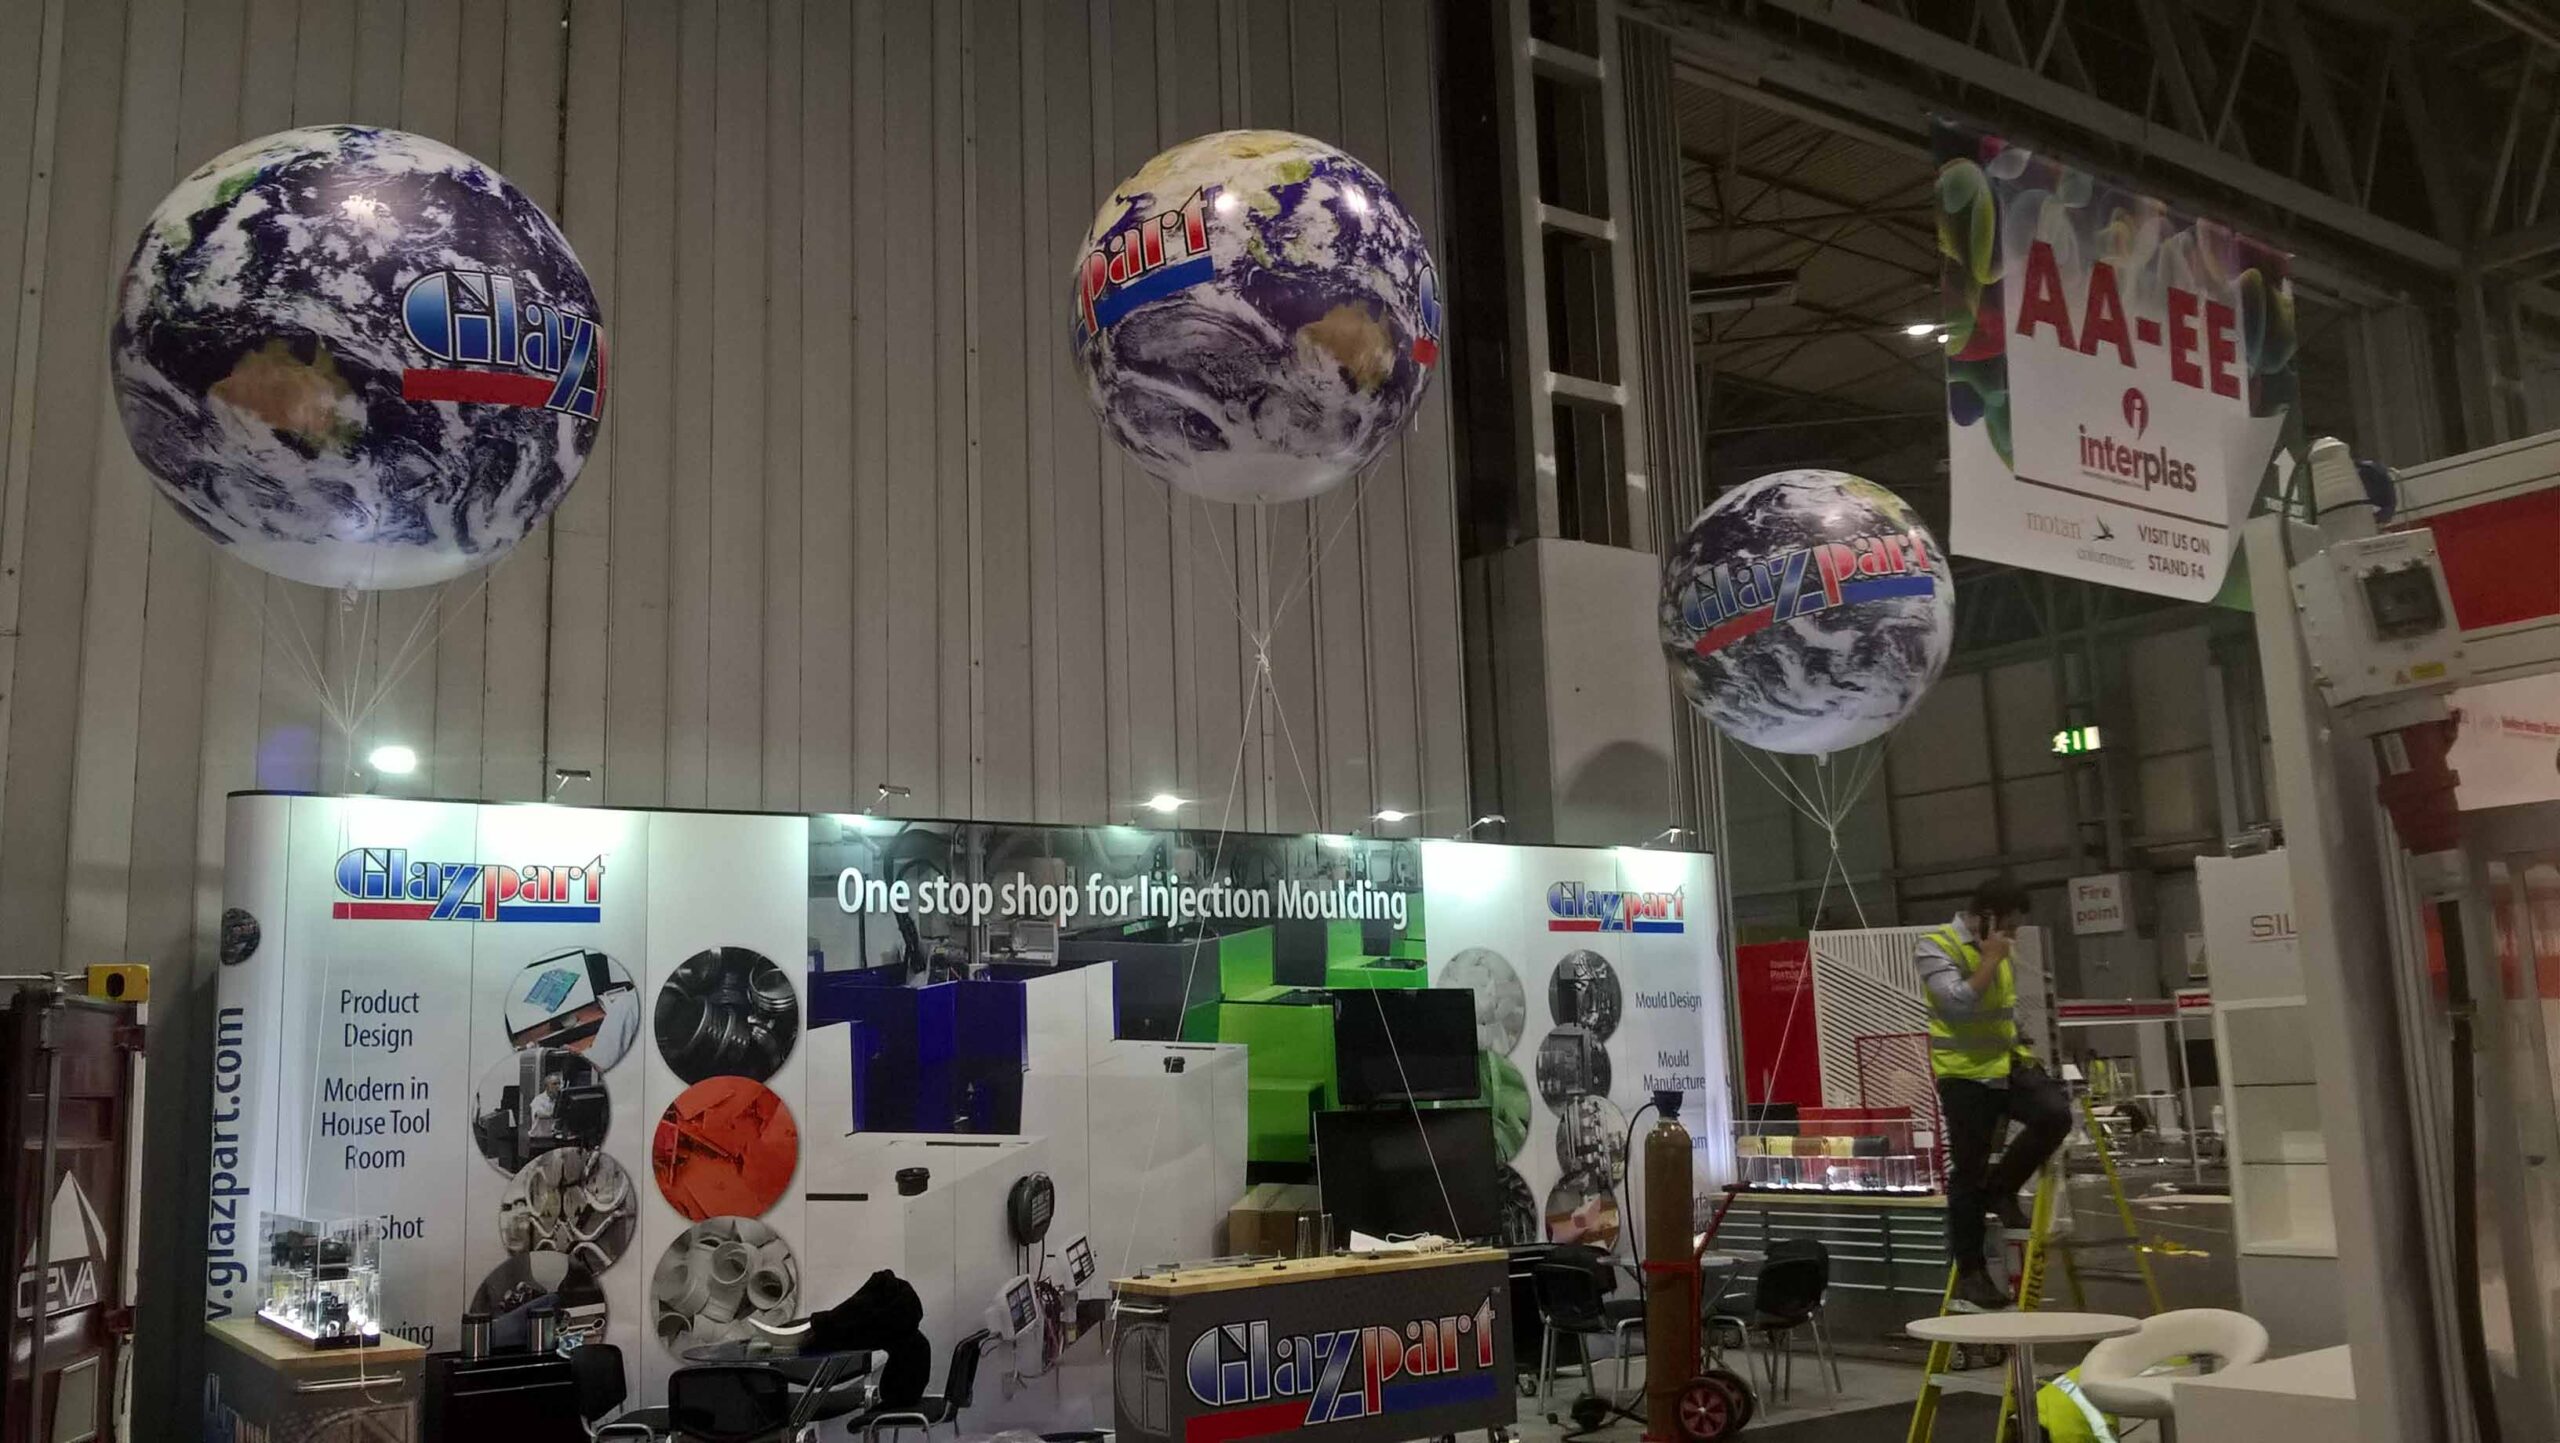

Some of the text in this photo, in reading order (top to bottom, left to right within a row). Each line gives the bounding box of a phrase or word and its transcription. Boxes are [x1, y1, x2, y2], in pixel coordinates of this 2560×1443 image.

[2016, 239, 2241, 400] AA-EE
[2078, 423, 2197, 493] interplas
[2138, 524, 2212, 555] VISIT US ON
[2148, 555, 2189, 578] STAND
[837, 867, 1407, 930] One stop shop for Injection Moulding
[341, 989, 420, 1014] Product
[1635, 991, 1702, 1012] Mould Design
[344, 1023, 413, 1053] Design
[1658, 1050, 1689, 1068] Mould
[324, 1076, 429, 1102] Modern in
[1643, 1074, 1706, 1091] Manufacture
[322, 1108, 430, 1137] House Tool
[345, 1145, 405, 1170] Room
